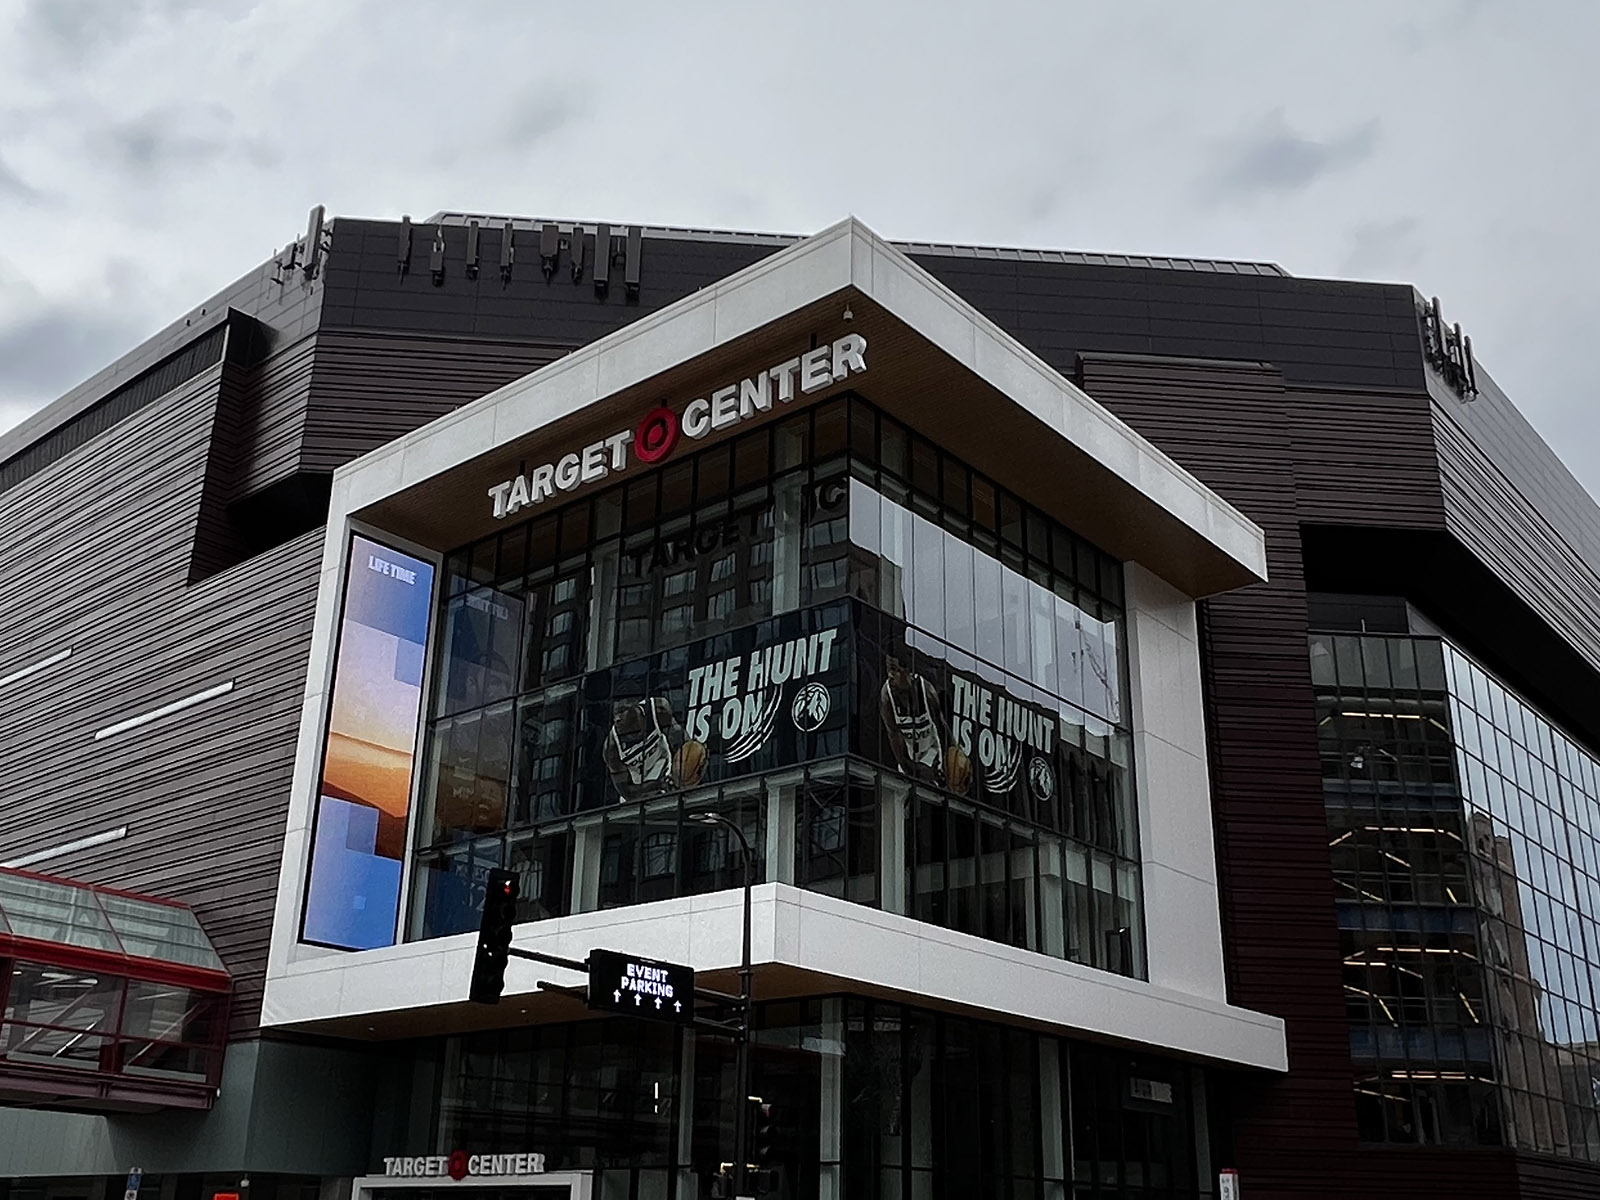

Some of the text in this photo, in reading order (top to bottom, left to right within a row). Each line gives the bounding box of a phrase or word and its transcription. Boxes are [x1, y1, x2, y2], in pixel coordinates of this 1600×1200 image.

[488, 333, 868, 519] TARGET CENTER
[368, 555, 418, 586] LIFE TIME
[688, 628, 839, 708] THE HUNT
[686, 690, 763, 744] IS ON
[951, 673, 1055, 755] THE HUNT
[953, 714, 973, 757] IS
[620, 975, 674, 998] PARKING
[626, 963, 669, 983] EVENT
[383, 1152, 545, 1176] TARGET CENTER
